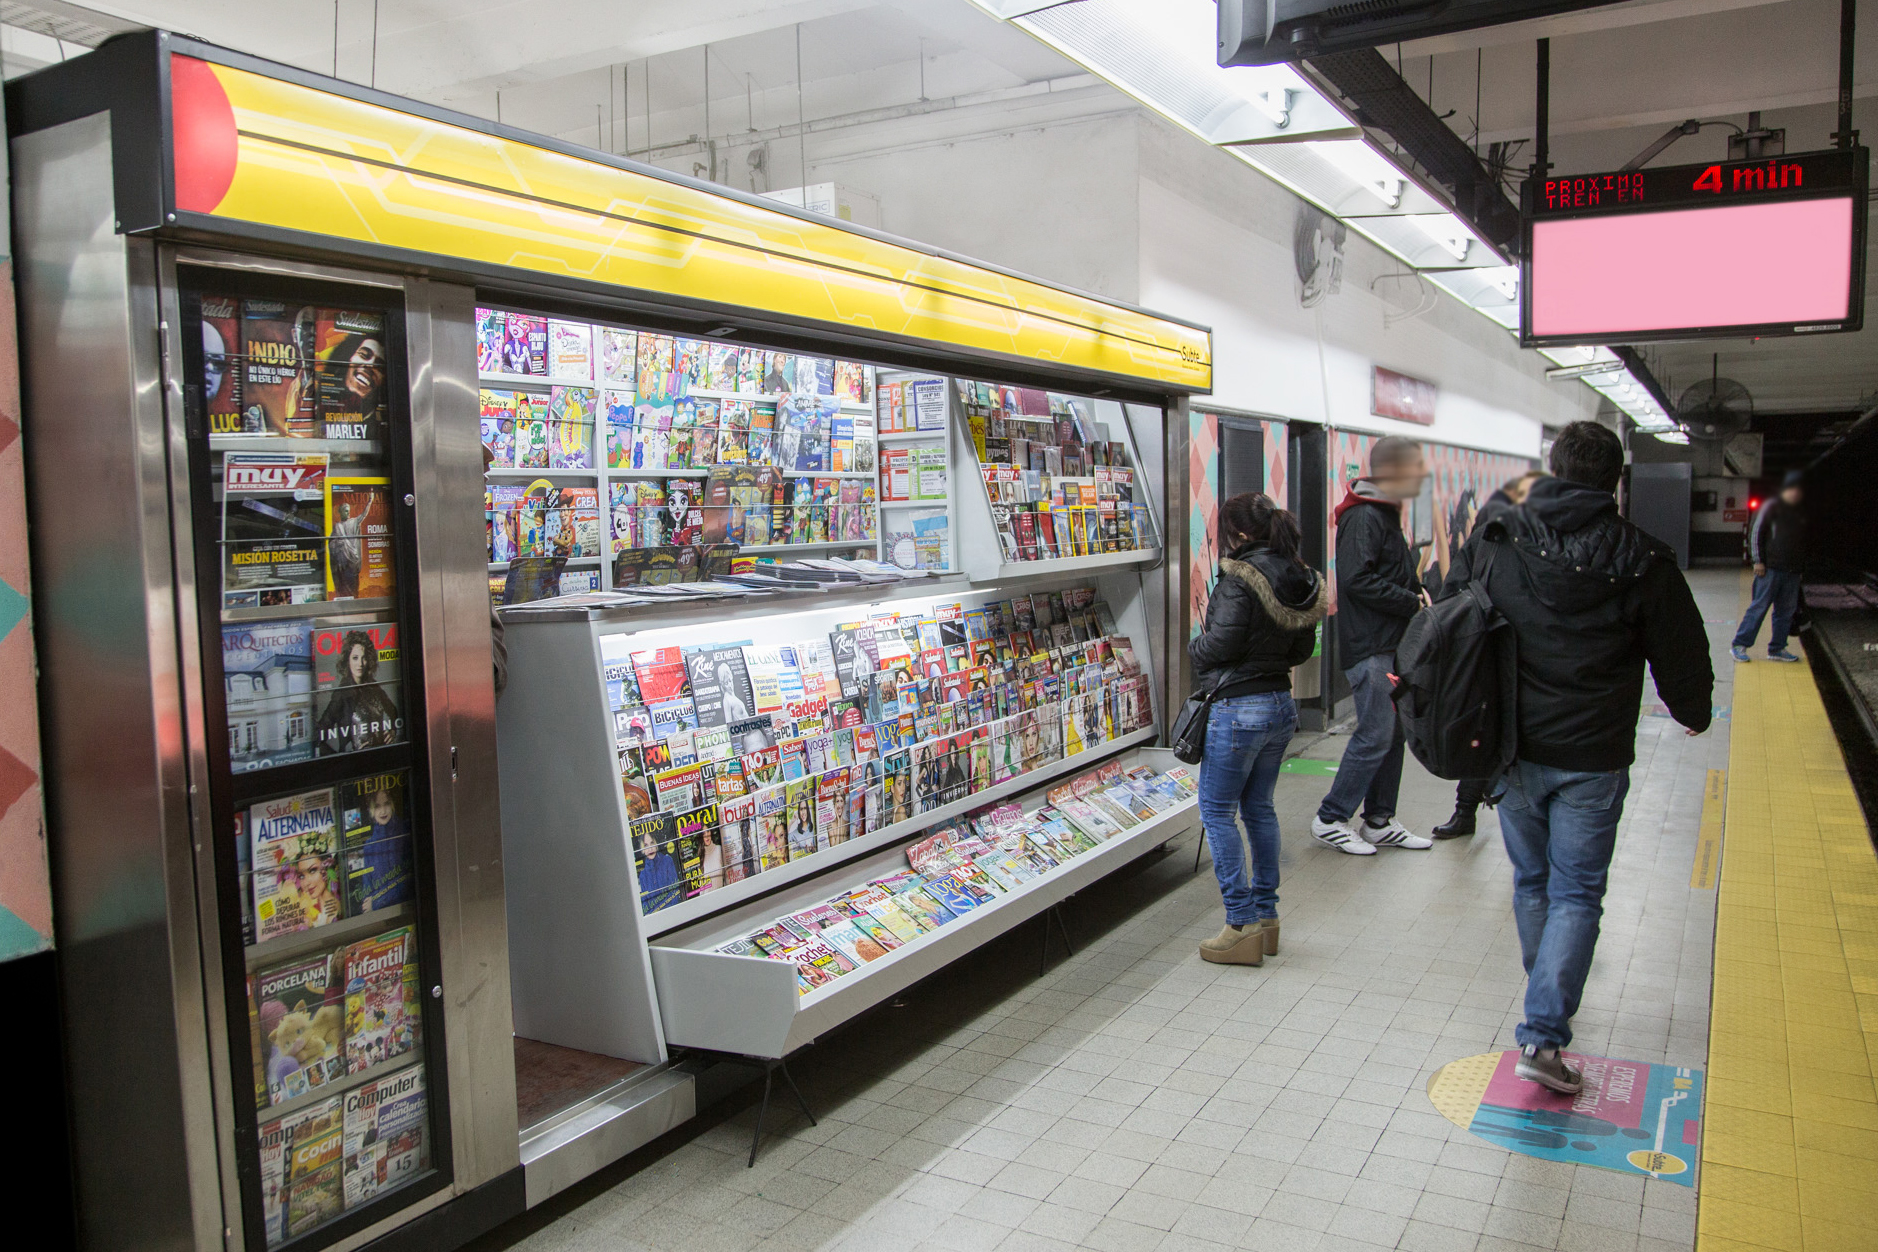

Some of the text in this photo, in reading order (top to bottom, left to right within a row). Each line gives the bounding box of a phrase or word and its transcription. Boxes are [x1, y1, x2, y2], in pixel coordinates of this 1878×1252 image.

[1546, 161, 1802, 195] PROXIMO 4 min
[1546, 187, 1644, 208] TREN EN
[248, 341, 297, 366] INDIO
[1181, 346, 1199, 363] Subte
[325, 411, 363, 422] REVOLUCIÓN
[326, 424, 367, 439] MARLEY
[986, 448, 1008, 459] pymes
[227, 468, 306, 488] muy
[496, 493, 518, 501] FROZEN
[576, 496, 597, 507] CREA
[1101, 501, 1114, 510] muy
[367, 525, 388, 533] ROMA
[232, 550, 318, 565] MISIÓN ROSETTA
[787, 695, 828, 718] Gadget
[320, 718, 404, 741] INVIERNO
[730, 718, 771, 735] contrastes
[742, 752, 763, 771] TAO
[660, 772, 700, 790] BUENAS IDEAS
[718, 778, 744, 792] tartas
[266, 801, 292, 819] Salud
[991, 807, 1023, 827] Gorros
[258, 806, 334, 843] ALTERNATIVA
[629, 818, 664, 837] TEJIDO
[928, 875, 963, 901] yoga
[348, 948, 404, 980] infantil
[261, 966, 327, 997] PORCELANA
[347, 1074, 418, 1113] Computer
[1606, 1065, 1637, 1104] ESPEREMOS
[358, 1104, 377, 1122] Hoy
[394, 1154, 412, 1172] 15
